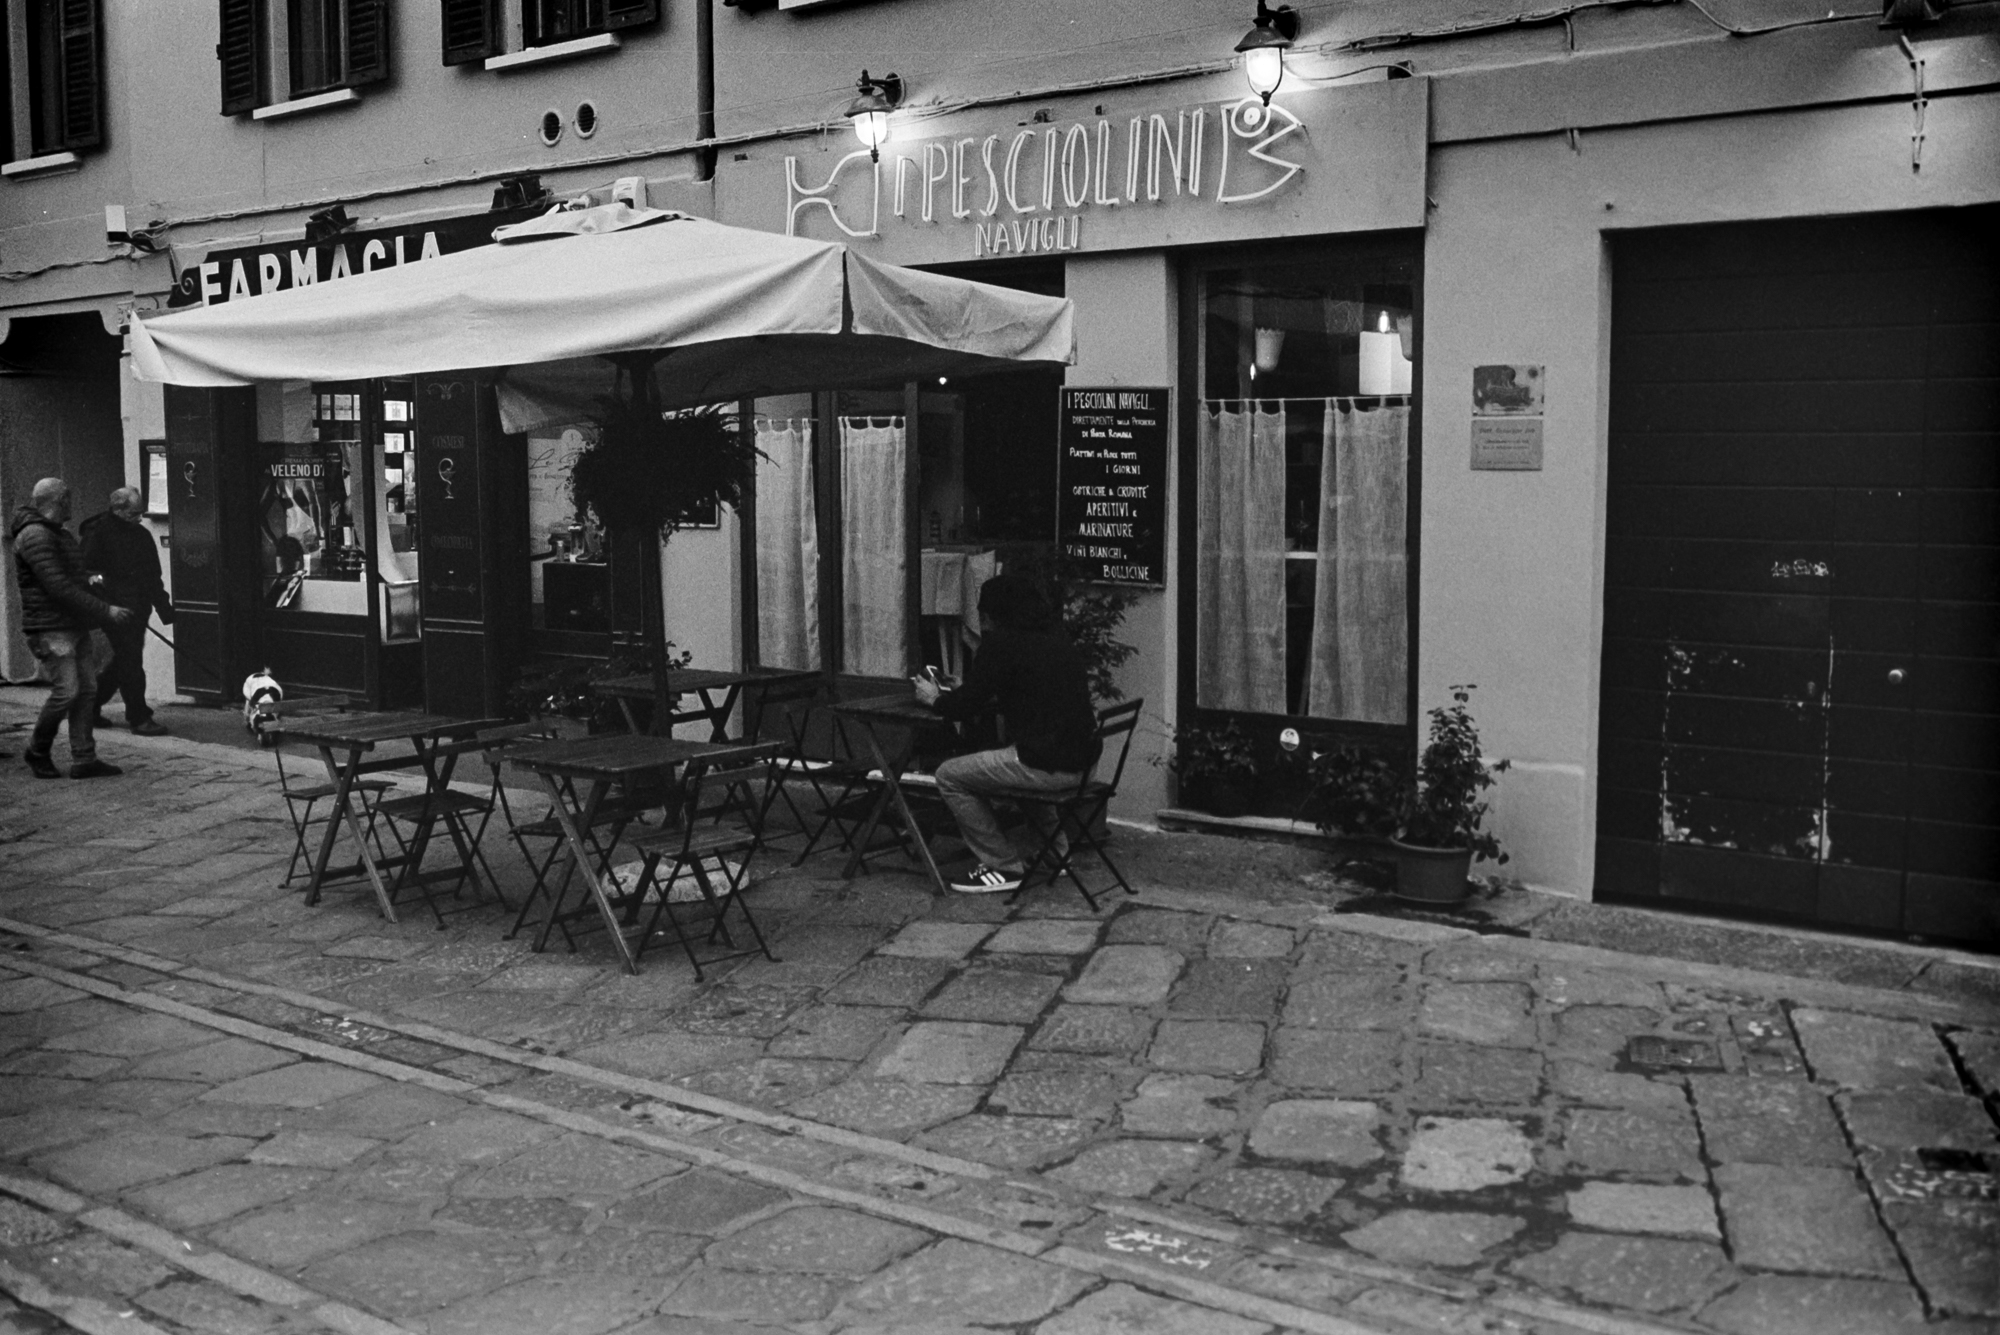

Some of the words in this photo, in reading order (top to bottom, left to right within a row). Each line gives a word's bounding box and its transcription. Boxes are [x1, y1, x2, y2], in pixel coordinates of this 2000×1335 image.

[893, 155, 906, 217] I
[922, 108, 1204, 222] PESCIOLINI
[974, 214, 1079, 256] NAVIGLI
[1074, 392, 1116, 409] PESCIOLINI
[1072, 415, 1114, 425] DIRETTAMENTE
[1090, 427, 1106, 438] PORTA
[1108, 428, 1133, 439] ROMANA
[1120, 451, 1137, 460] TUTTI
[271, 464, 310, 477] VELENO
[1112, 464, 1141, 475] GIORNI
[1072, 486, 1106, 497] OSTRICHE
[1086, 502, 1128, 517] APERITIVI
[1078, 522, 1134, 538] MARINATURE
[1089, 545, 1122, 558] BIANCHI
[1102, 564, 1150, 581] BOLLICINE
